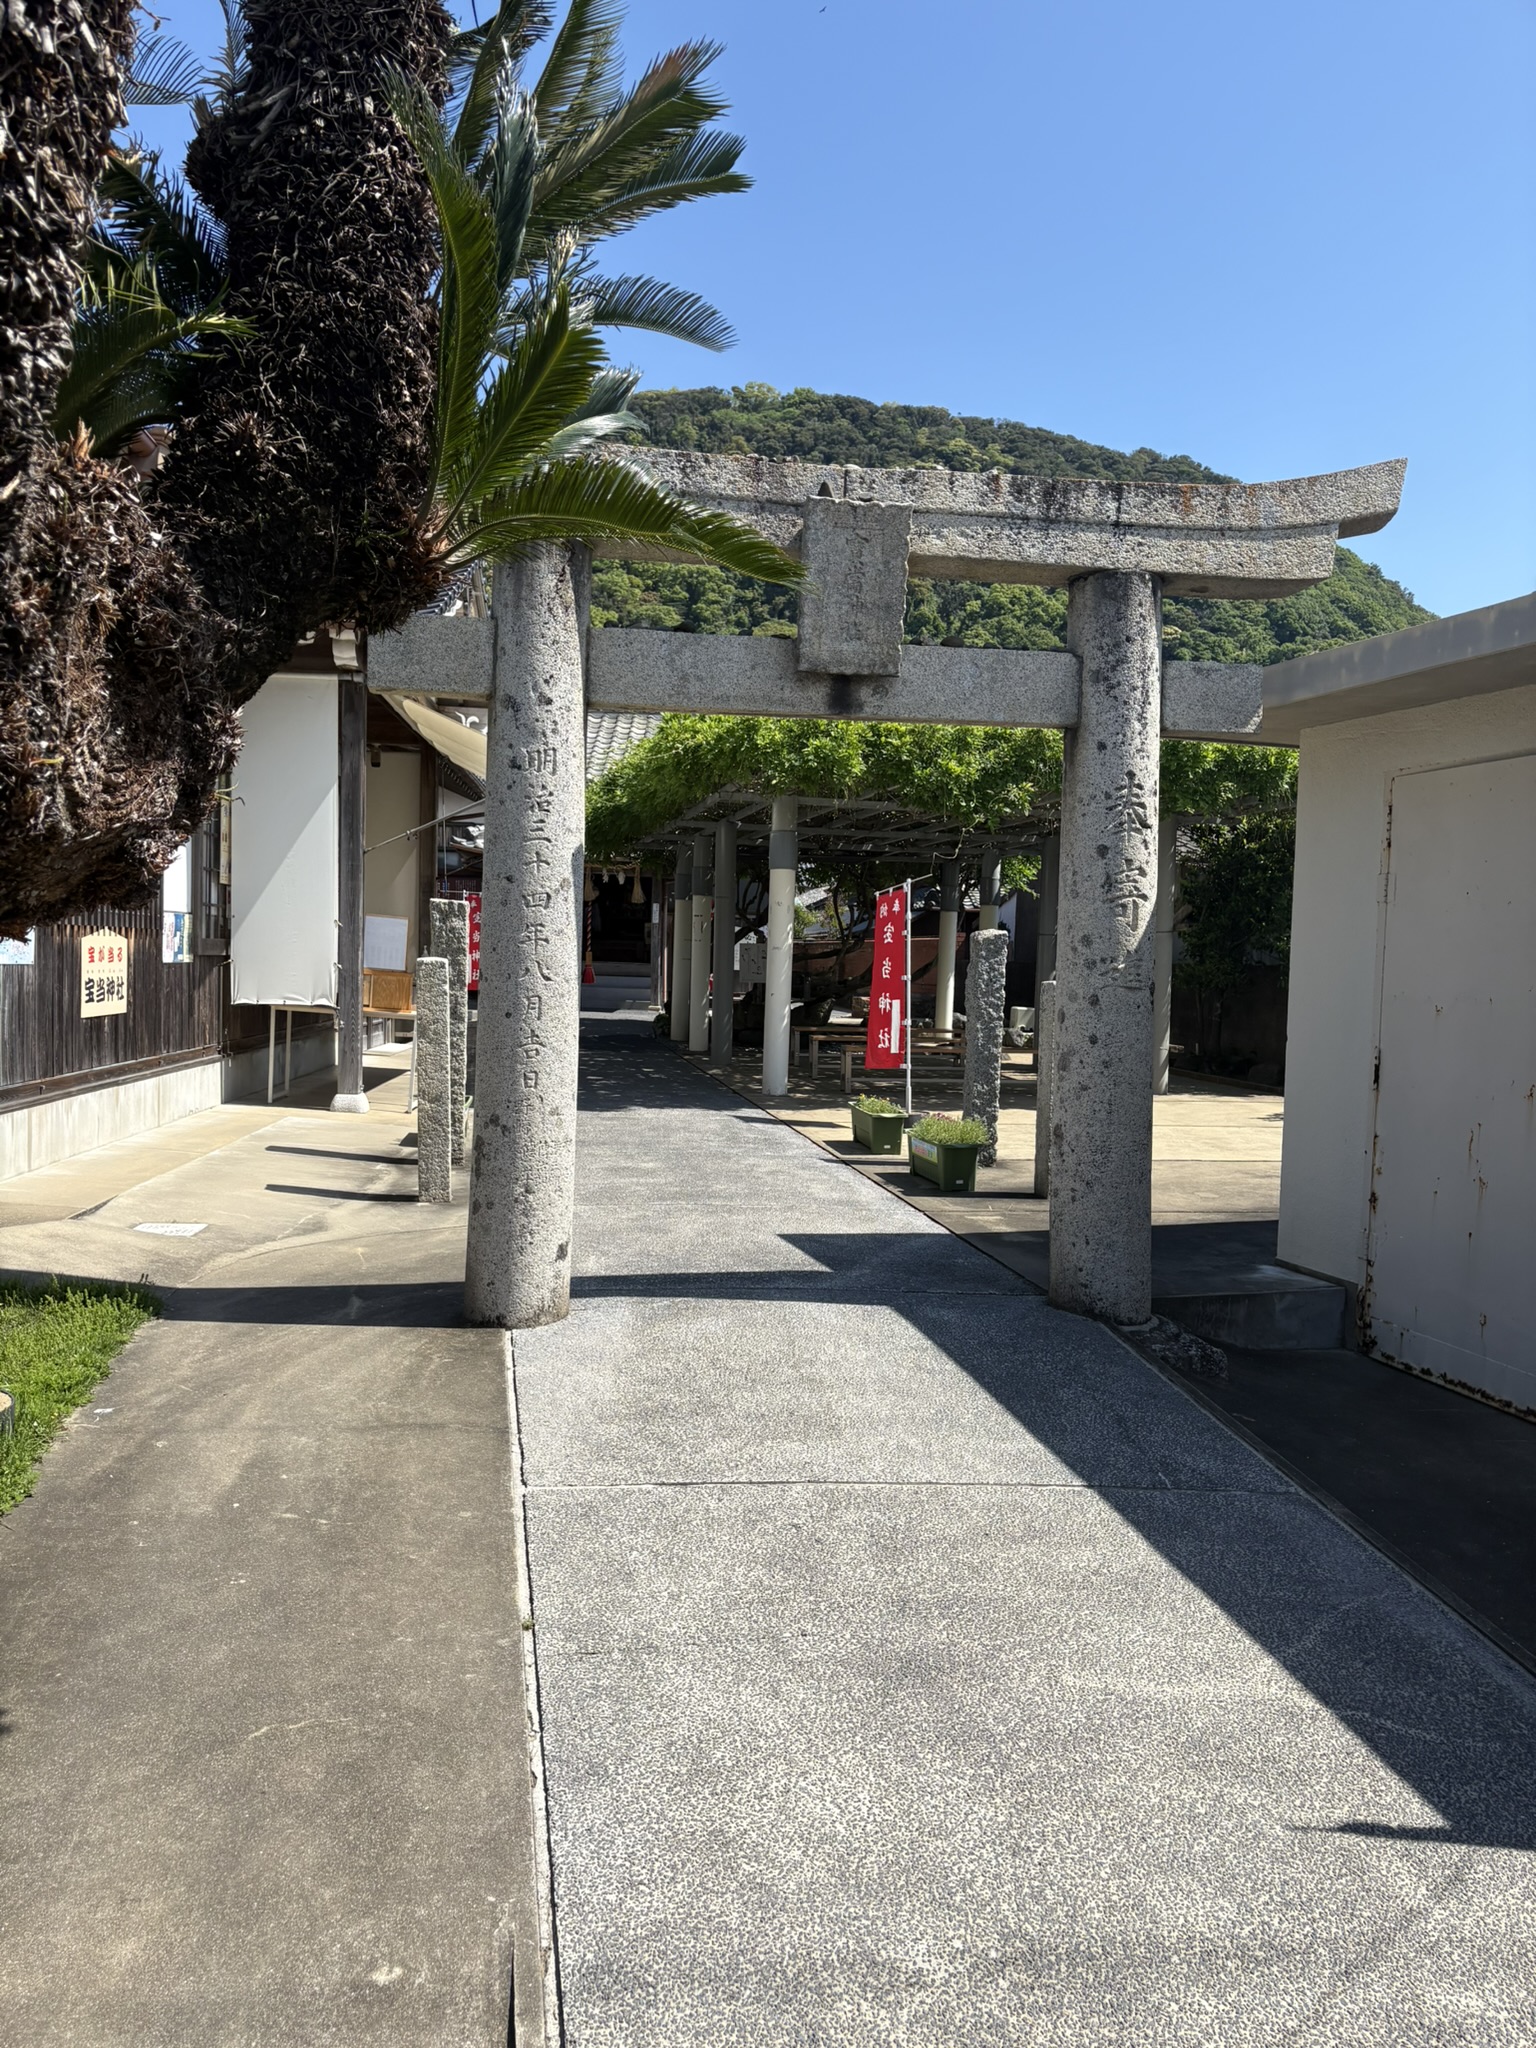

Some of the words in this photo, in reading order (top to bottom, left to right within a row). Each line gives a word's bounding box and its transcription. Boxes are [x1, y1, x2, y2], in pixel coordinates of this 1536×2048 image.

[519, 746, 558, 1089] 明治三十四年八月吉日
[87, 945, 123, 963] 宝が当る
[84, 976, 125, 1004] 宝当神社
